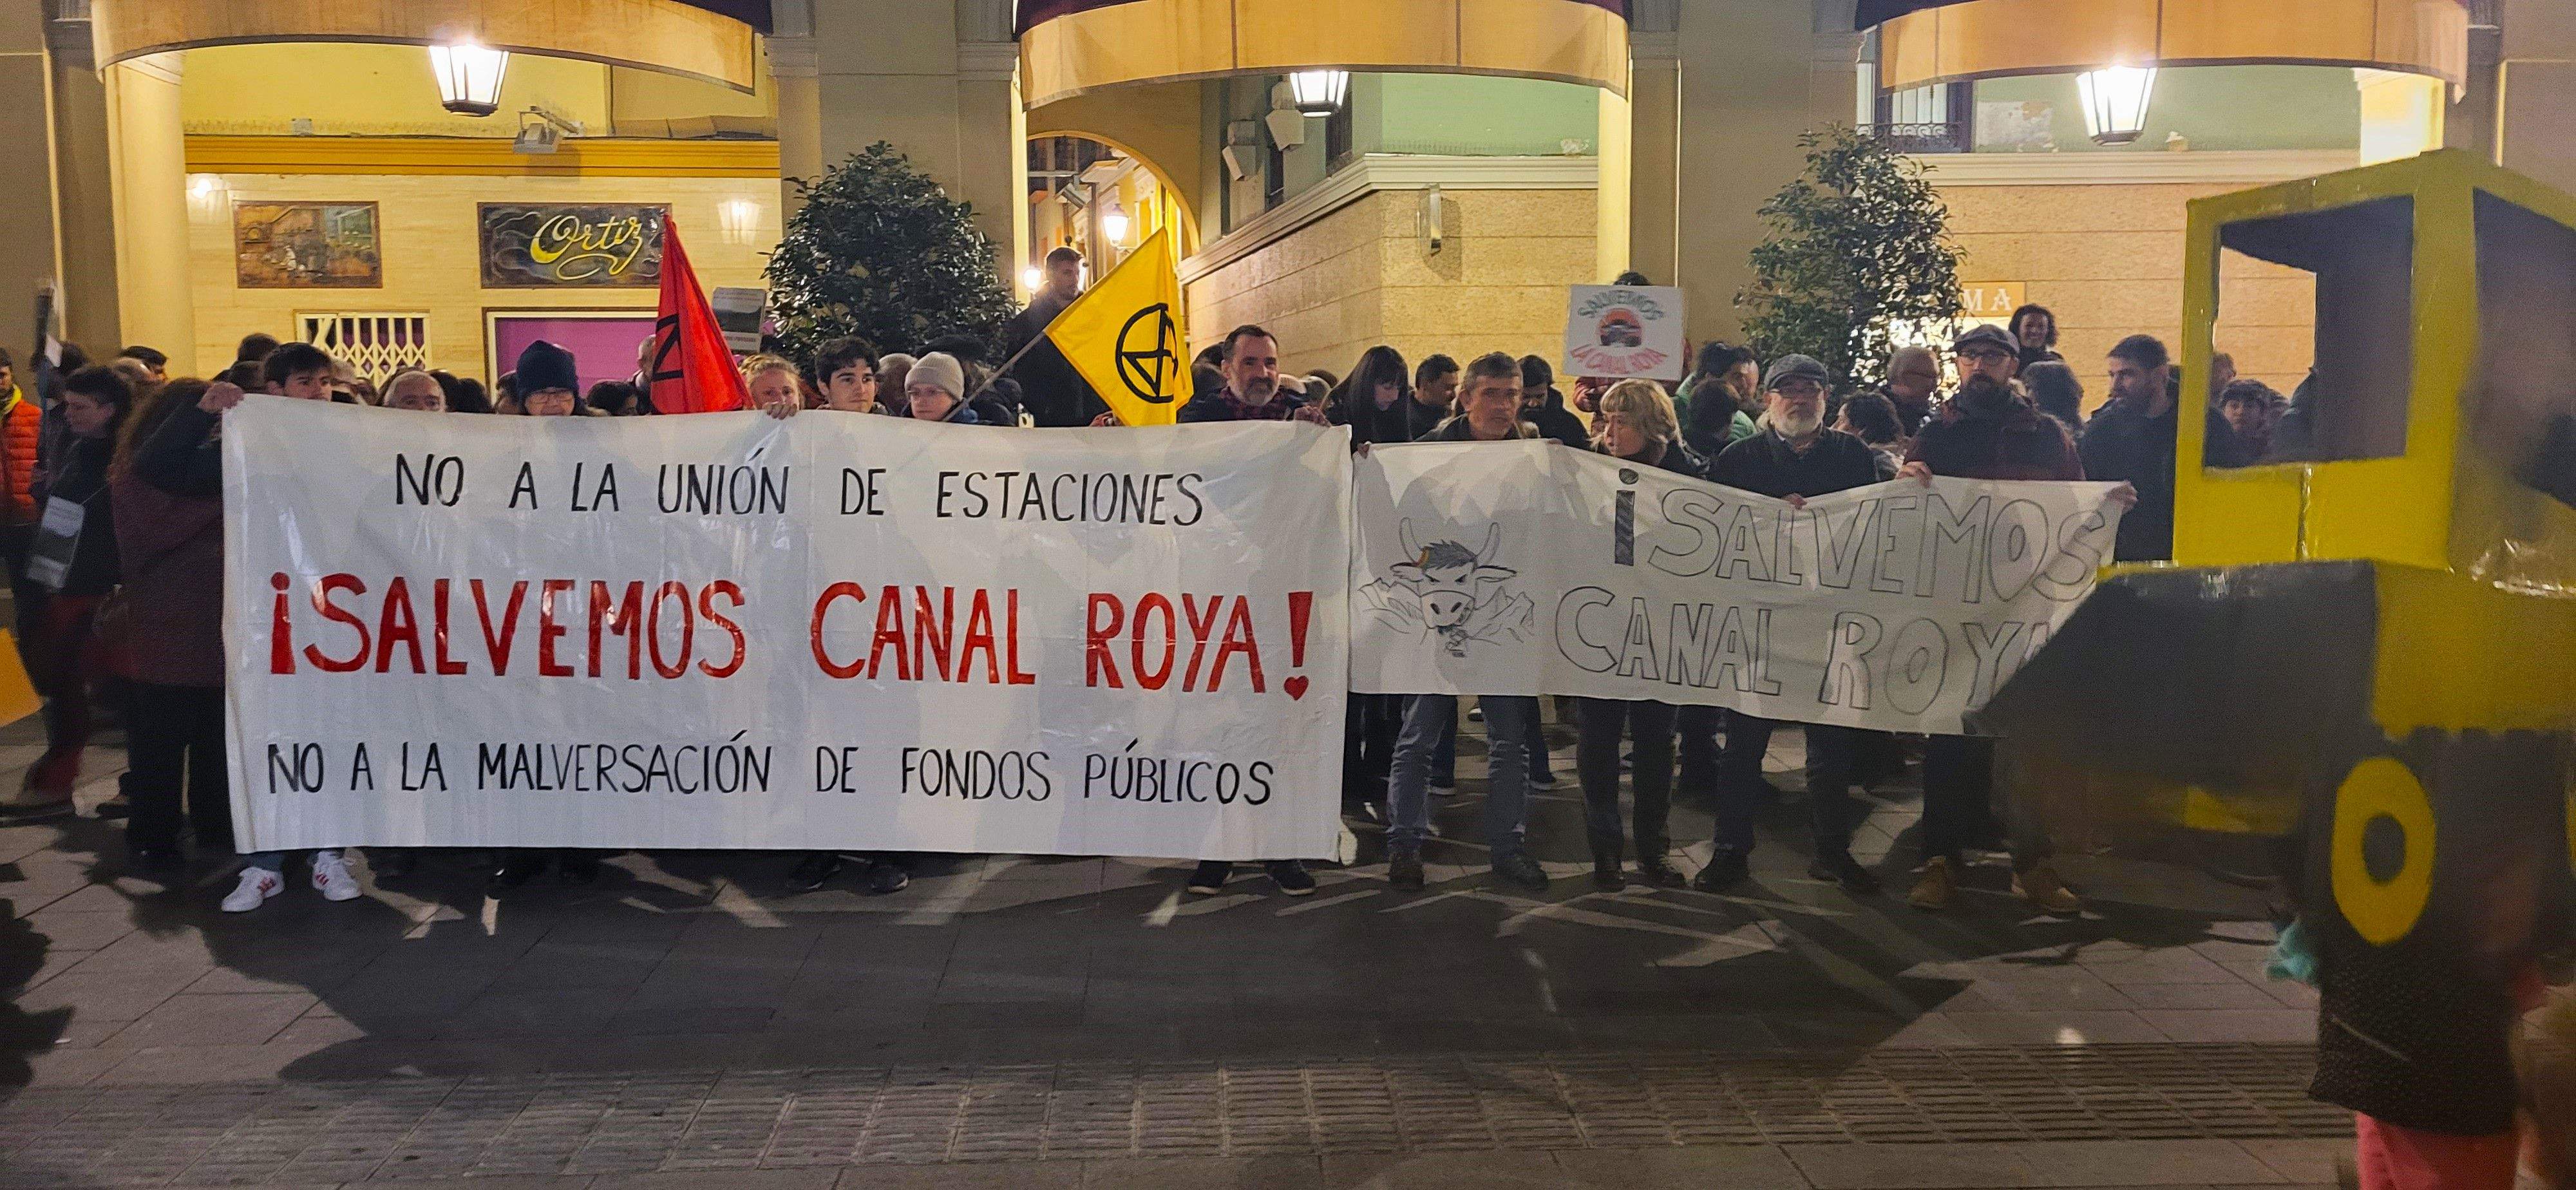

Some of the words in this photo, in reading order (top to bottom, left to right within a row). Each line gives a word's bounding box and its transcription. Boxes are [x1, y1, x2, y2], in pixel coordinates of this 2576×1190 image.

[530, 214, 643, 280] Ortiz
[1578, 290, 1664, 320] SALVEMOS
[395, 453, 464, 507] NO
[509, 462, 538, 509] A
[571, 462, 619, 511] LA
[658, 448, 790, 515] UNIÓN
[840, 468, 886, 515] DE
[937, 471, 1203, 526] ESTACIONES
[270, 571, 746, 681] ¡SALVEMOS
[810, 581, 1036, 685] CANAL
[1555, 586, 1782, 696] CANAL
[268, 742, 324, 793] NO
[350, 742, 374, 790] A
[401, 742, 448, 791] LA
[478, 730, 772, 793] MALVERSACIÓN
[816, 746, 858, 793] DE
[902, 747, 1051, 801] FONDOS
[1084, 737, 1274, 805] PÚBLICOS
